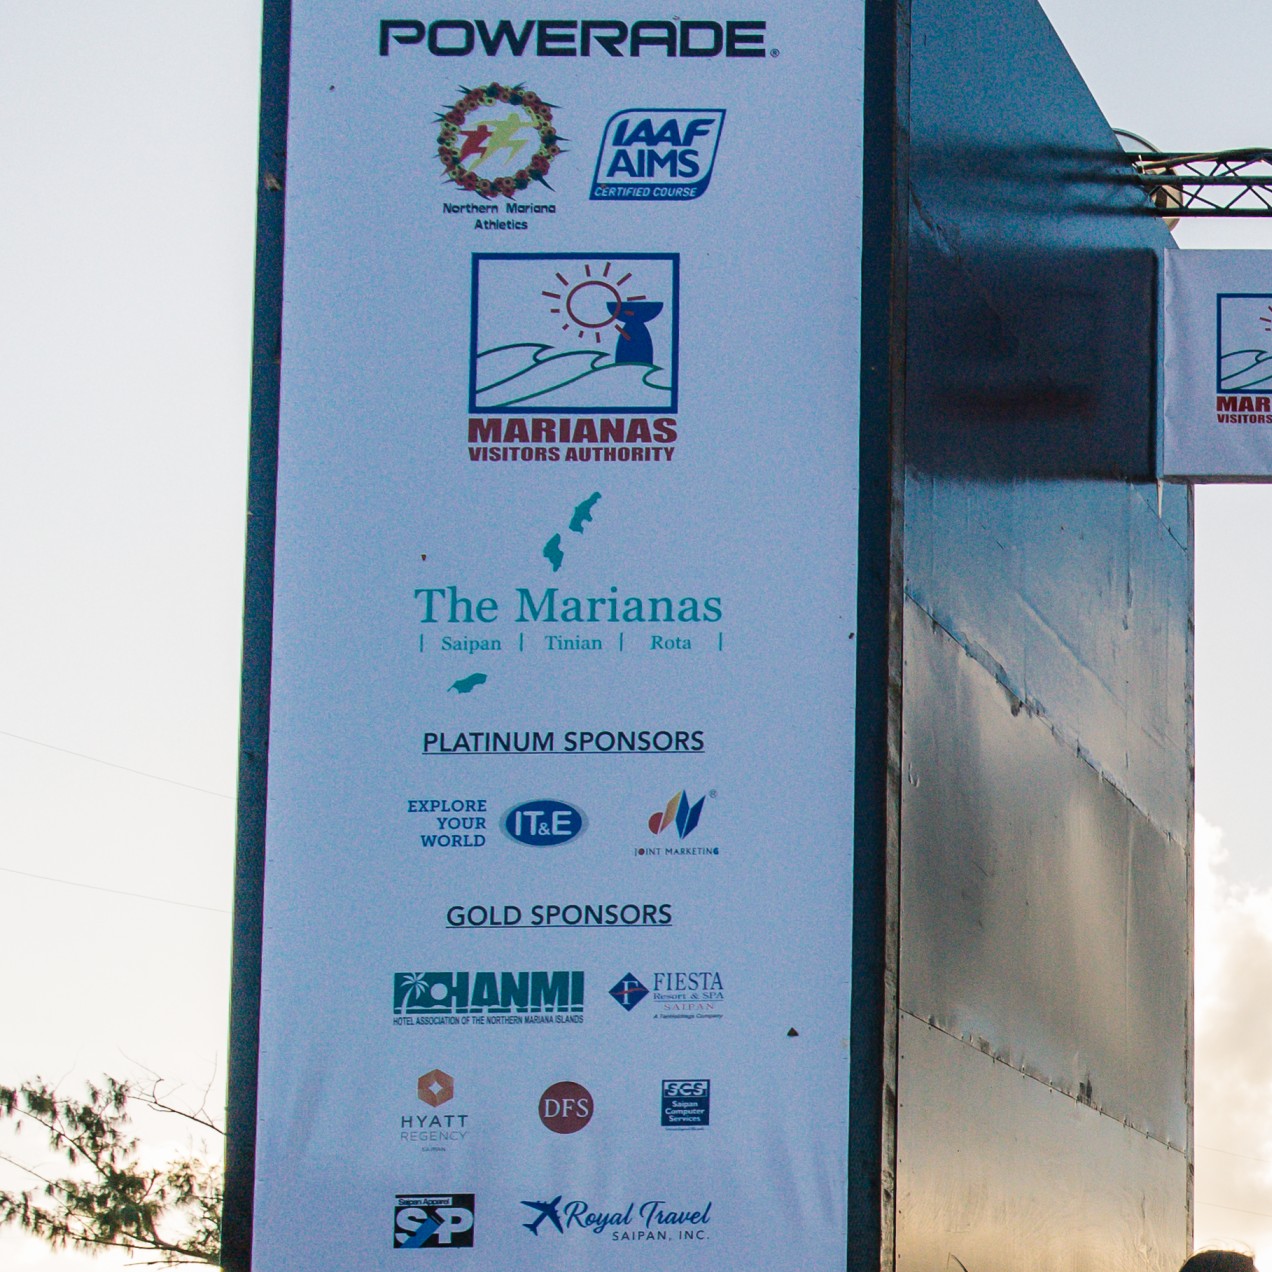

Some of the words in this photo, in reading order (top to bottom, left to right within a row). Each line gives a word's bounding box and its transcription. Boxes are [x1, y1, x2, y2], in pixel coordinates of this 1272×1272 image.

[379, 19, 767, 58] POWERADE
[613, 117, 717, 147] IAAF
[607, 149, 699, 179] AIMS
[594, 186, 650, 198] CERTIFIED
[652, 186, 698, 198] COURSE
[443, 203, 499, 215] Northern
[505, 203, 556, 214] Mariana
[474, 218, 528, 231] Athletics
[468, 417, 678, 444] MARIANAS
[468, 446, 560, 462] VISITORS
[565, 446, 675, 462] AUTHORITY
[414, 586, 499, 624] The
[516, 586, 723, 624] Marianas
[441, 635, 501, 654] Saipan
[545, 635, 602, 651] Tinian
[650, 635, 692, 651] Rota
[423, 731, 555, 752] PLATINUM
[563, 730, 705, 752] SPONSORS
[407, 799, 487, 814] EXPLORE
[437, 816, 487, 831] YOUR
[514, 809, 572, 837] IT&E
[420, 833, 487, 848] WORLD
[634, 847, 661, 857] JOINT
[665, 846, 720, 856] MARKETING
[446, 905, 521, 927] GOLD
[530, 904, 673, 927] SPONSORS
[653, 971, 724, 991] FIESTA
[441, 971, 584, 1013] HANMI
[702, 991, 724, 999] SPA
[663, 1003, 715, 1011] SAIPAN
[393, 1016, 415, 1026] HOTEL
[416, 1016, 460, 1025] ASSOCIATION
[461, 1016, 469, 1025] OF
[470, 1016, 484, 1025] THE
[486, 1015, 523, 1024] NORTHERN
[524, 1015, 554, 1024] MARIANA
[555, 1014, 584, 1024] ISLANDS
[667, 1082, 703, 1096] SCS
[543, 1098, 589, 1119] DFS
[665, 1108, 705, 1117] Computer
[671, 1101, 698, 1109] Saipan
[401, 1115, 469, 1128] HYATT
[400, 1131, 468, 1142] REGENCY
[564, 1200, 633, 1233] Royal
[639, 1200, 712, 1225] Travel
[612, 1231, 672, 1242] SAIPAN,
[679, 1230, 710, 1241] INC.
